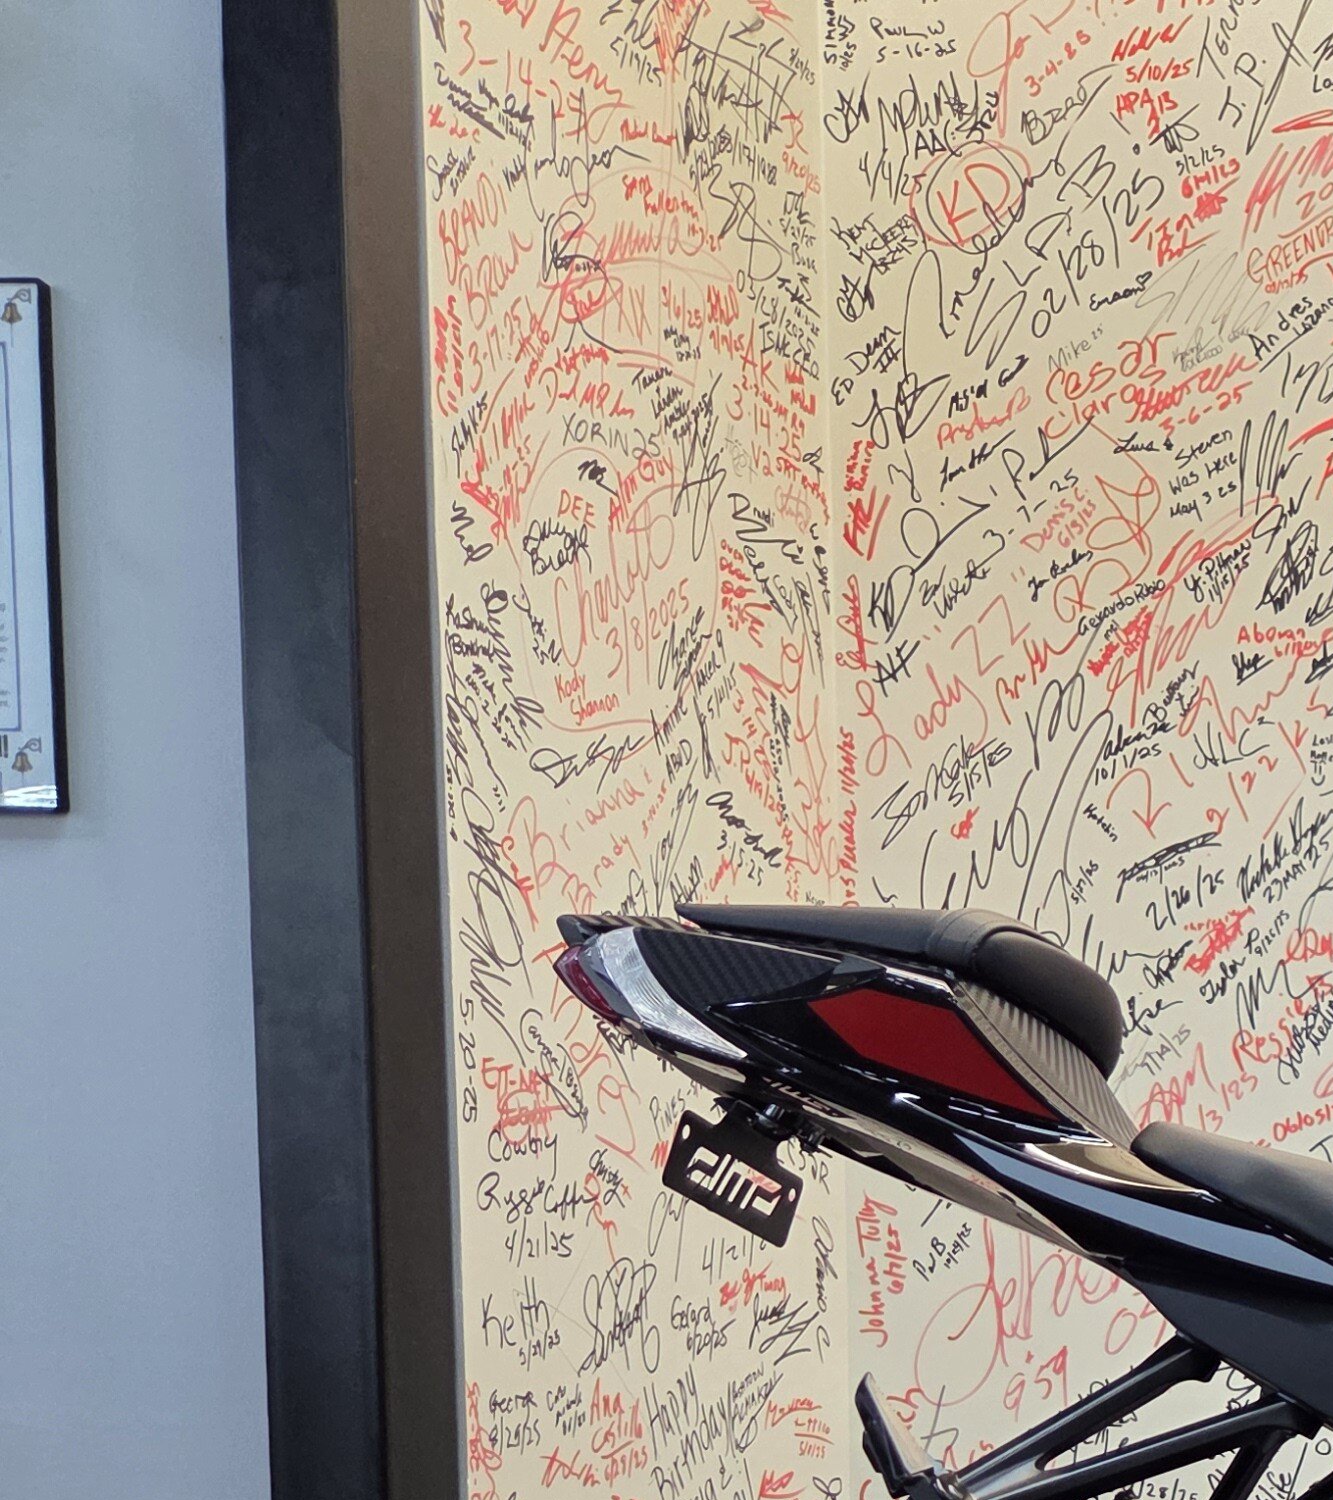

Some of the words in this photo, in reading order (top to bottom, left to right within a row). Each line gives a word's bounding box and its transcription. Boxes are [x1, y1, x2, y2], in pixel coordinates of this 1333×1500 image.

[556, 488, 596, 528] DEE
[588, 1377, 626, 1426] Ana
[642, 1363, 700, 1461] Happy
[650, 1385, 737, 1497] Birthday
